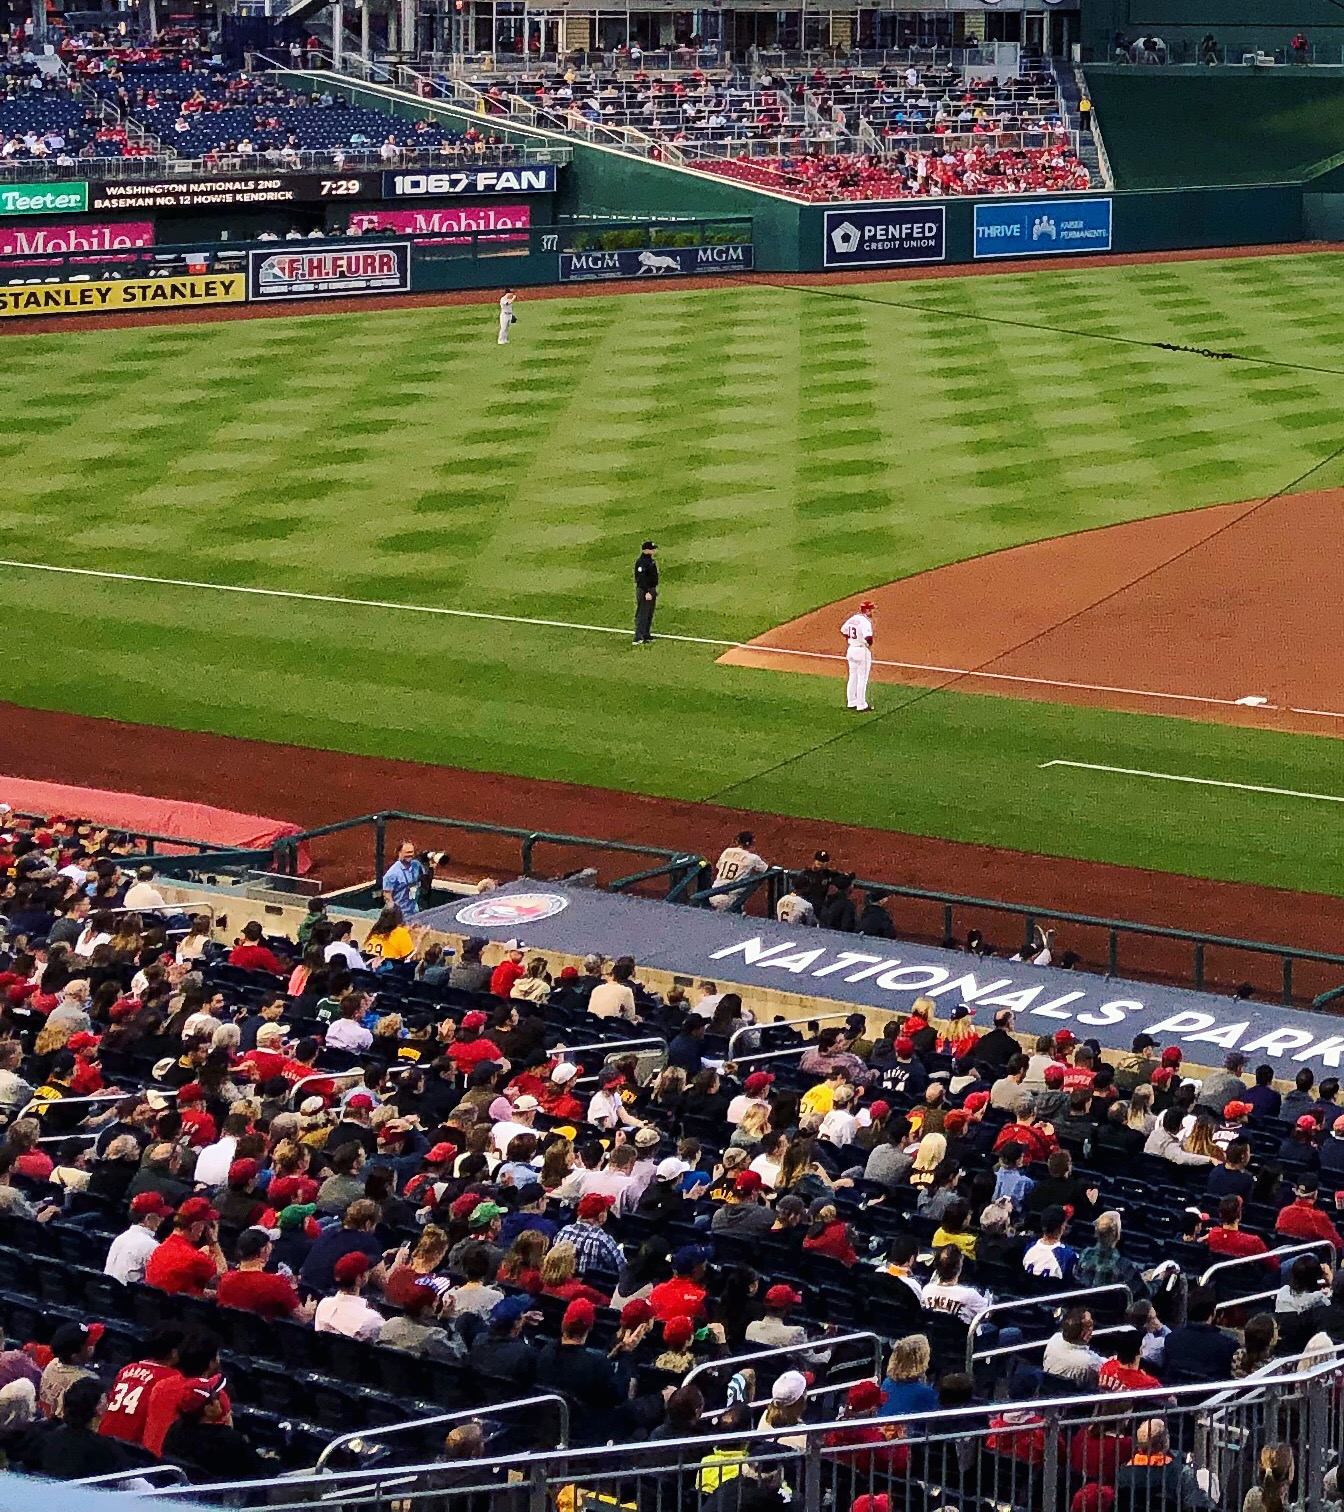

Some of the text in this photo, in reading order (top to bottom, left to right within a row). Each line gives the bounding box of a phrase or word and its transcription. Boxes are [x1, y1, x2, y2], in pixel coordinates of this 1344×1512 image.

[106, 179, 281, 196] WASHINGTON NATIONALS 2ND
[320, 179, 359, 195] 7:29
[476, 171, 546, 191] FAN
[2, 191, 81, 210] Teeter
[94, 196, 153, 209] BASEMAN
[179, 195, 191, 205] 12
[194, 192, 234, 205] HOWIE
[236, 190, 293, 202] KENDRICK
[864, 223, 937, 239] PENFED
[977, 223, 1020, 238] THRIVE
[541, 234, 558, 252] 377
[864, 238, 935, 250] CREDIT UNION
[571, 253, 619, 270] MGM
[697, 246, 744, 263] MGM
[122, 279, 236, 303] STANLEY
[719, 860, 739, 880] 18
[709, 937, 1144, 1027] NATIONALS
[108, 1382, 144, 1415] 34
